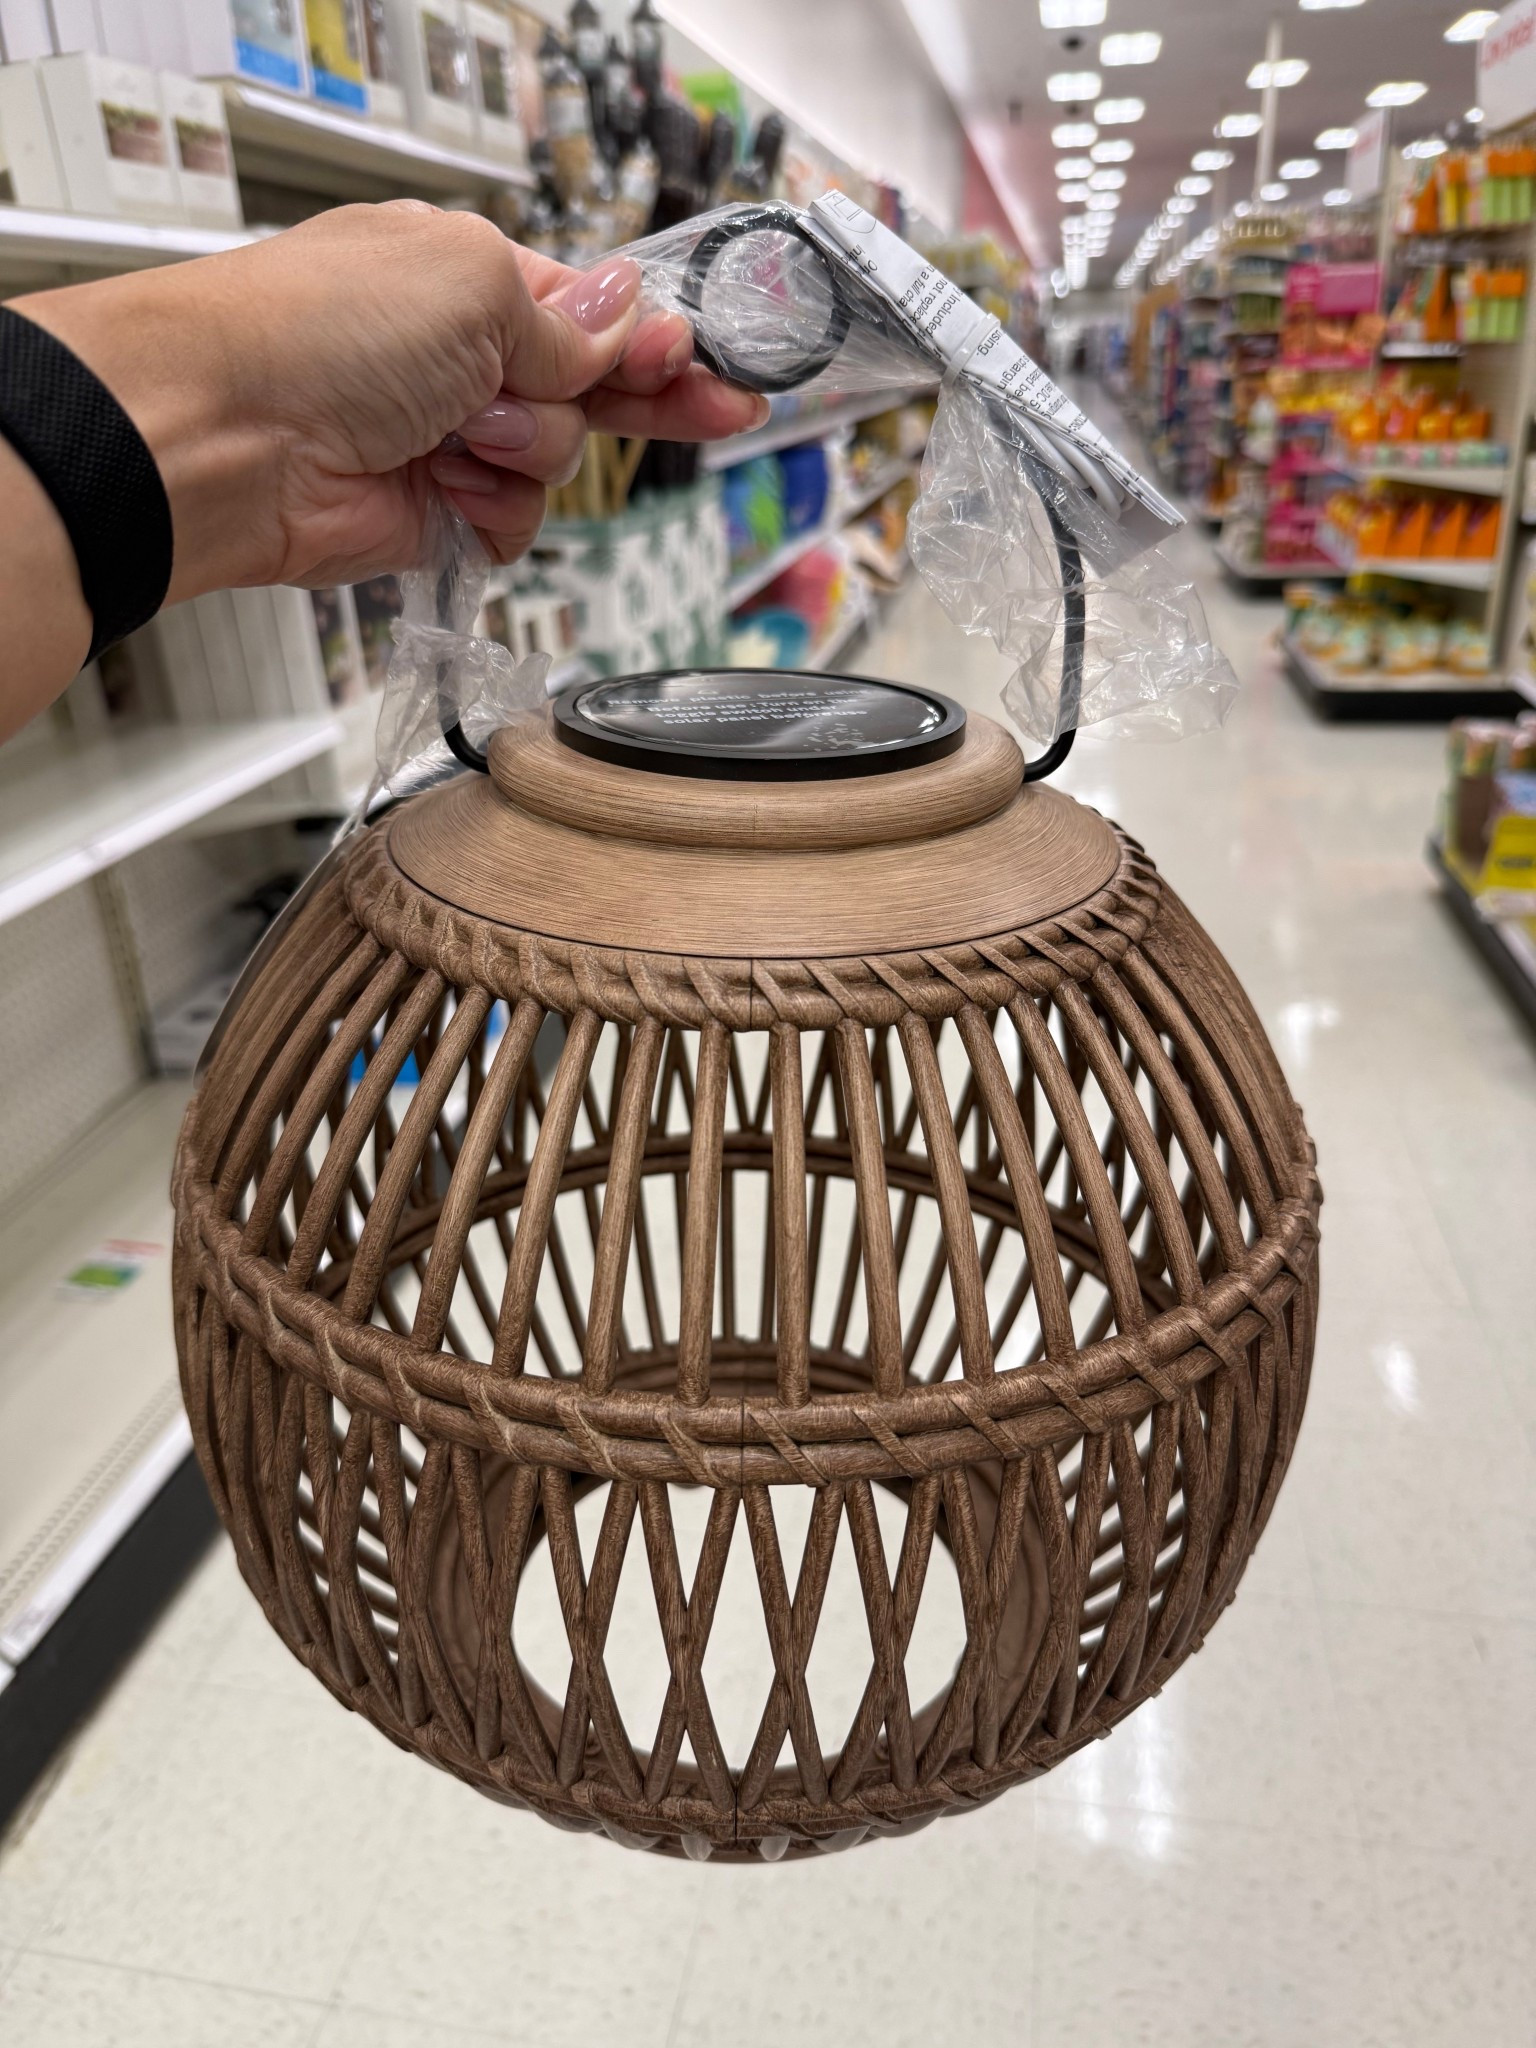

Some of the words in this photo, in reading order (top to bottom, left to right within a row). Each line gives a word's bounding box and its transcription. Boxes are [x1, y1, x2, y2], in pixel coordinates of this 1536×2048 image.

[920, 271, 929, 281] a
[911, 278, 926, 296] full
[932, 278, 948, 294] not
[976, 328, 1003, 356] using.
[1036, 388, 1051, 403] DC
[607, 698, 680, 706] Remove
[757, 691, 817, 699] before
[824, 689, 871, 697] using
[647, 704, 711, 712] Before
[720, 707, 784, 715] switch
[715, 713, 769, 723] panel
[769, 710, 832, 718] before
